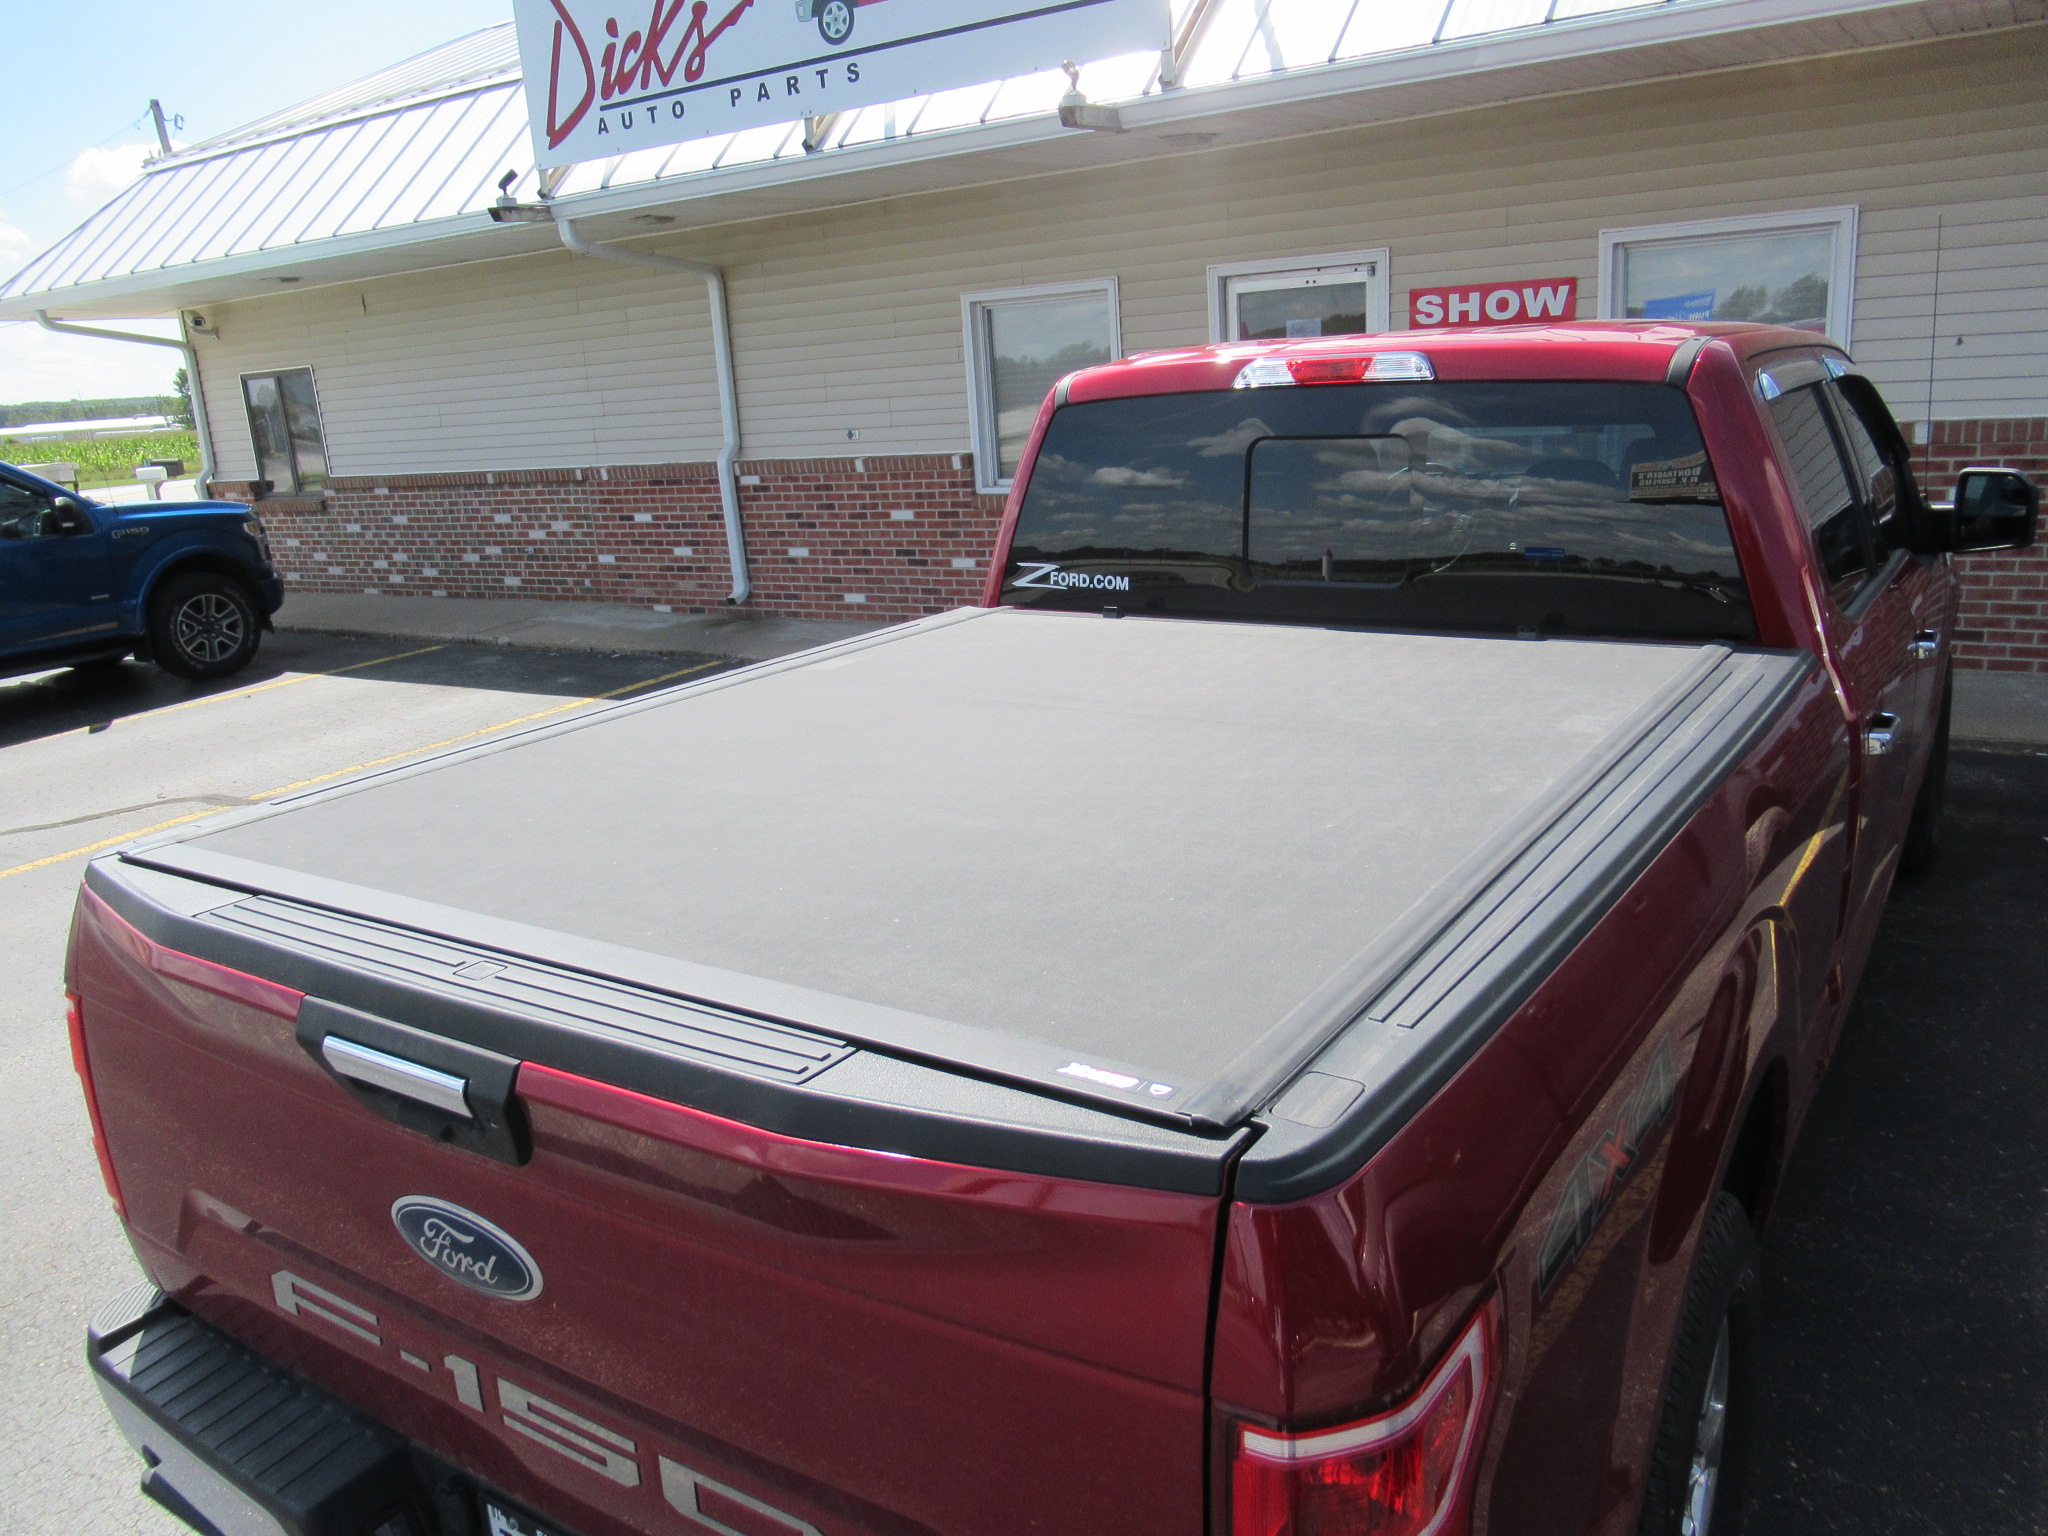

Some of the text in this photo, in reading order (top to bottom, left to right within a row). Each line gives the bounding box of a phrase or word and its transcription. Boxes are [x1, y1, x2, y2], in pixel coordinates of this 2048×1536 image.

[598, 62, 860, 135] AUTO PARTS
[1415, 285, 1570, 325] SHOW
[420, 1217, 498, 1284] Ford
